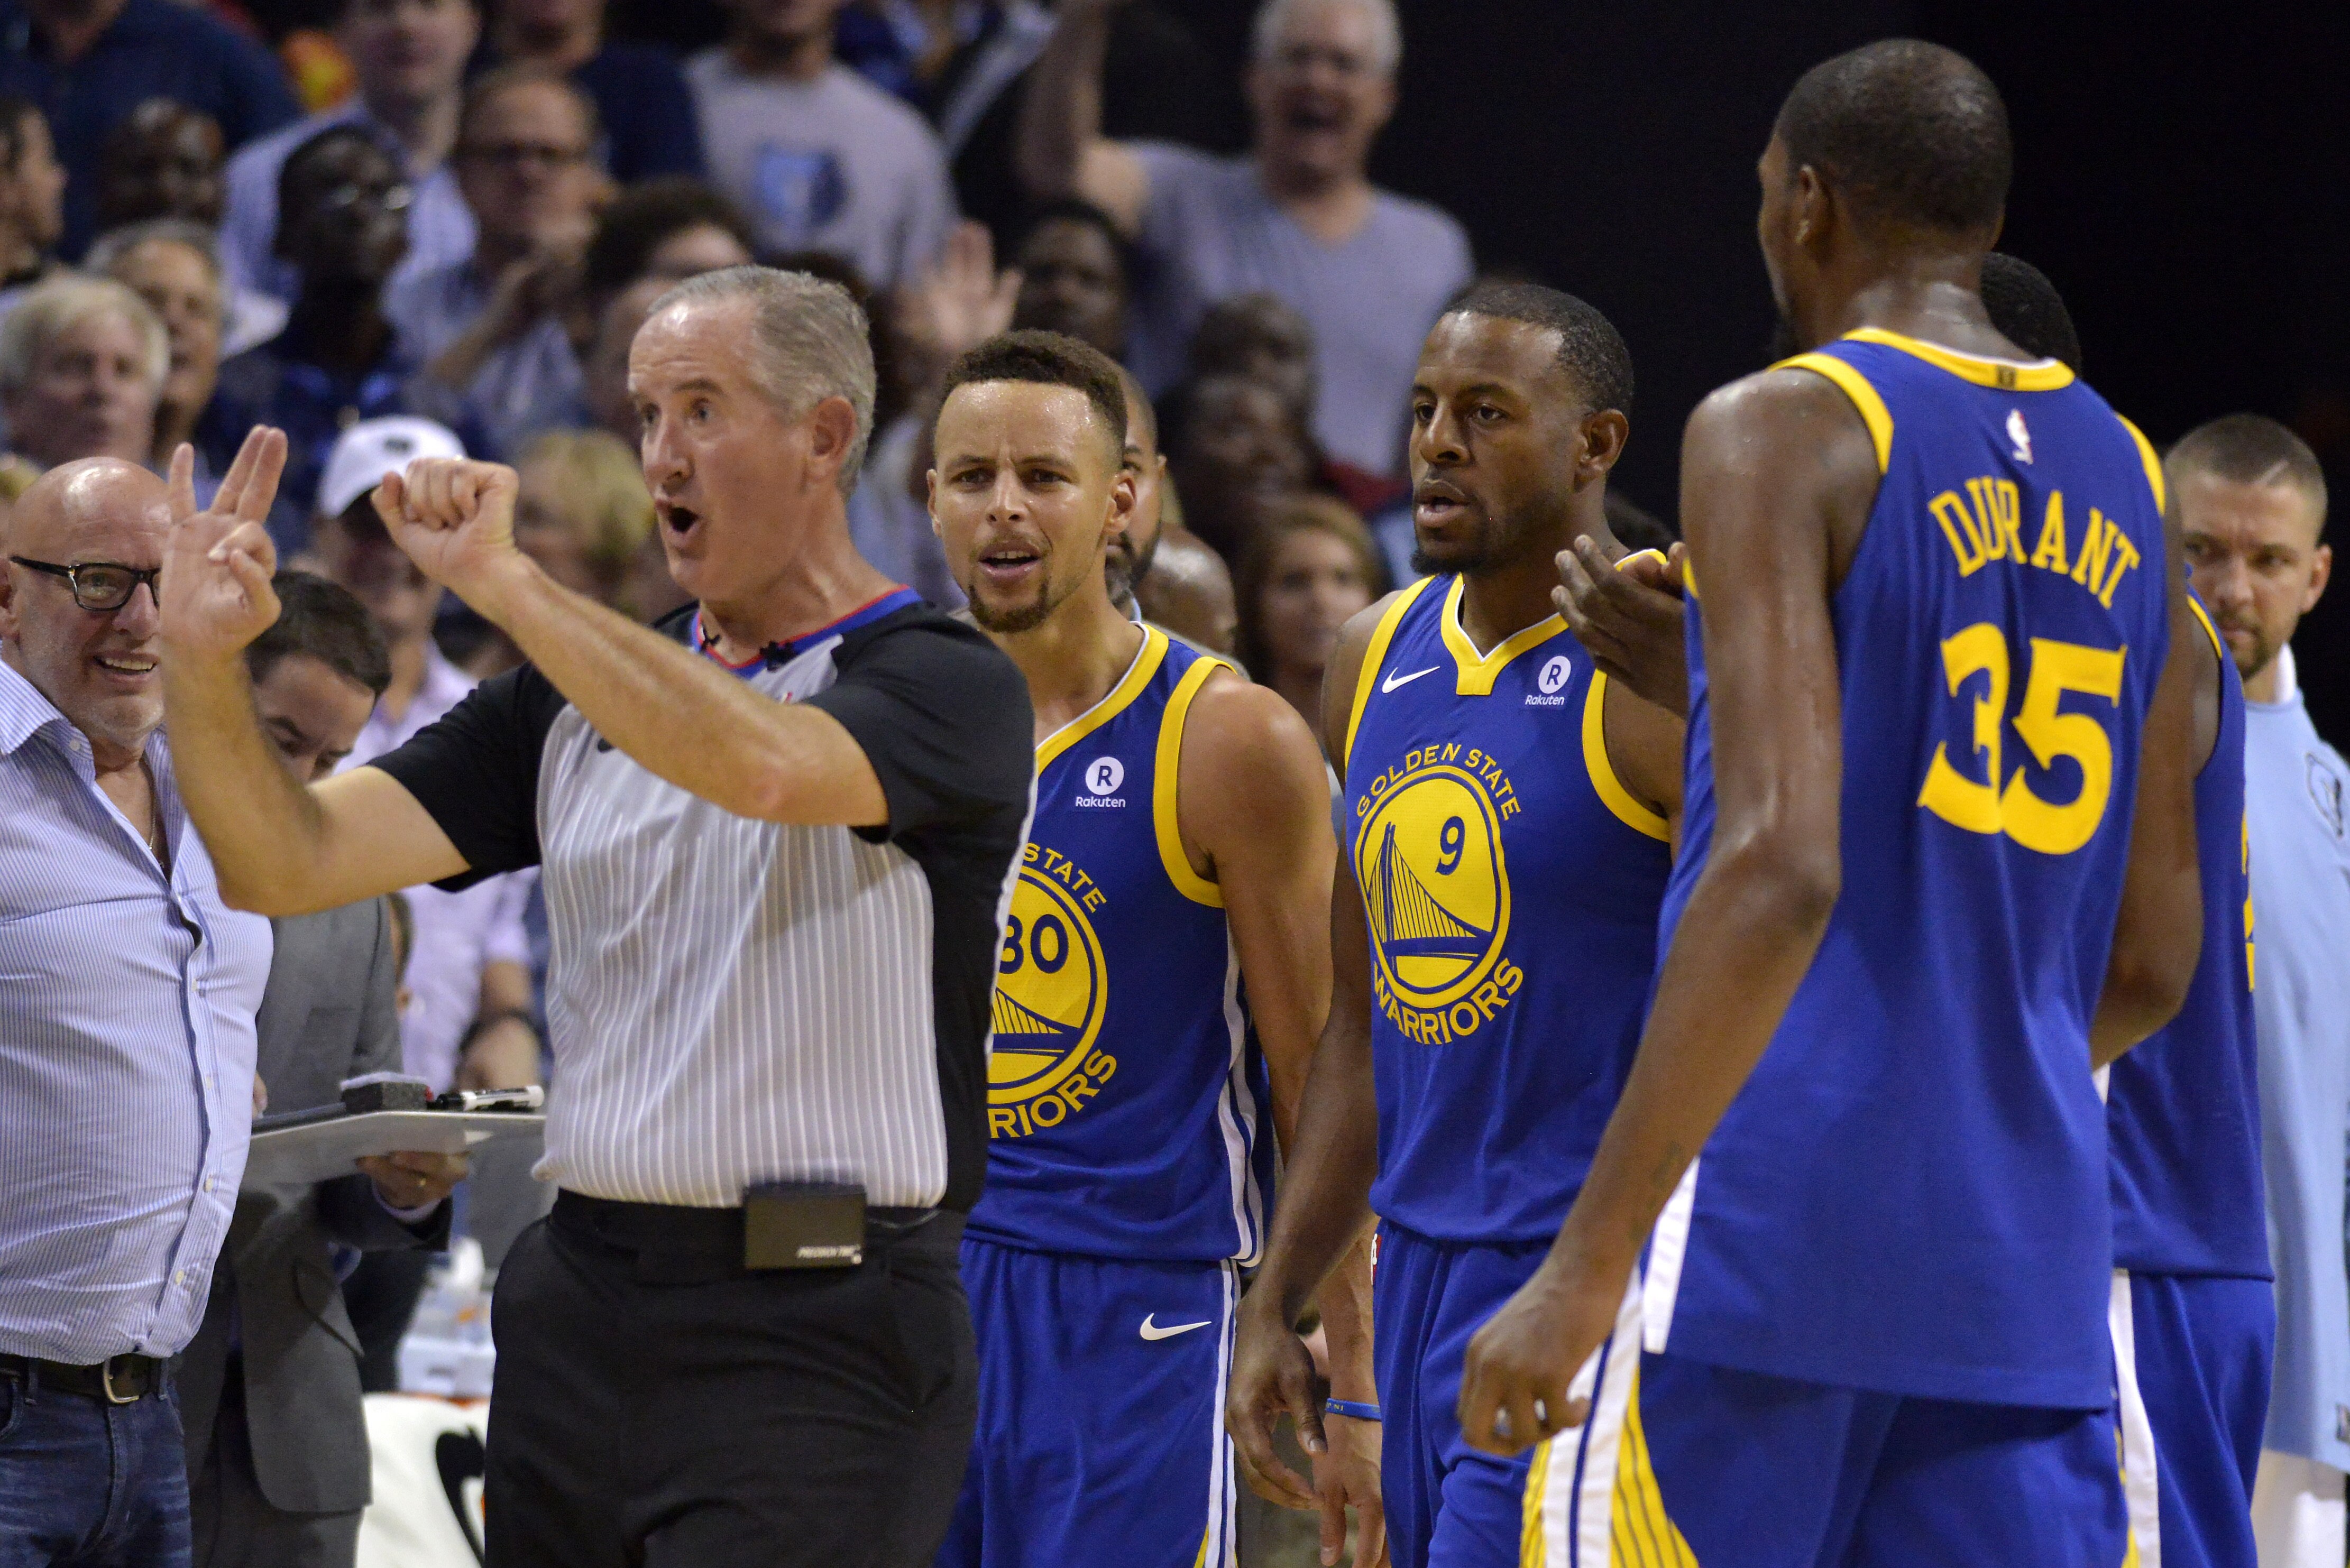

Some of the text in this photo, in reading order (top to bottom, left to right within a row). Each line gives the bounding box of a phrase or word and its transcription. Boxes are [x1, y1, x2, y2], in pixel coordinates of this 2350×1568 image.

[1928, 475, 2141, 610] DURANT
[1525, 694, 1565, 706] Rakuten
[1546, 664, 1562, 686] R
[1916, 622, 2127, 855] 35
[1075, 796, 1126, 808] Rakuten
[1097, 765, 1113, 787] R
[1357, 743, 1521, 821] GOLDEN STATE
[1023, 842, 1107, 914] STATE
[1435, 815, 1466, 876] 9
[1374, 957, 1523, 1045] WARRIORS
[987, 1048, 1117, 1139] RIORS
